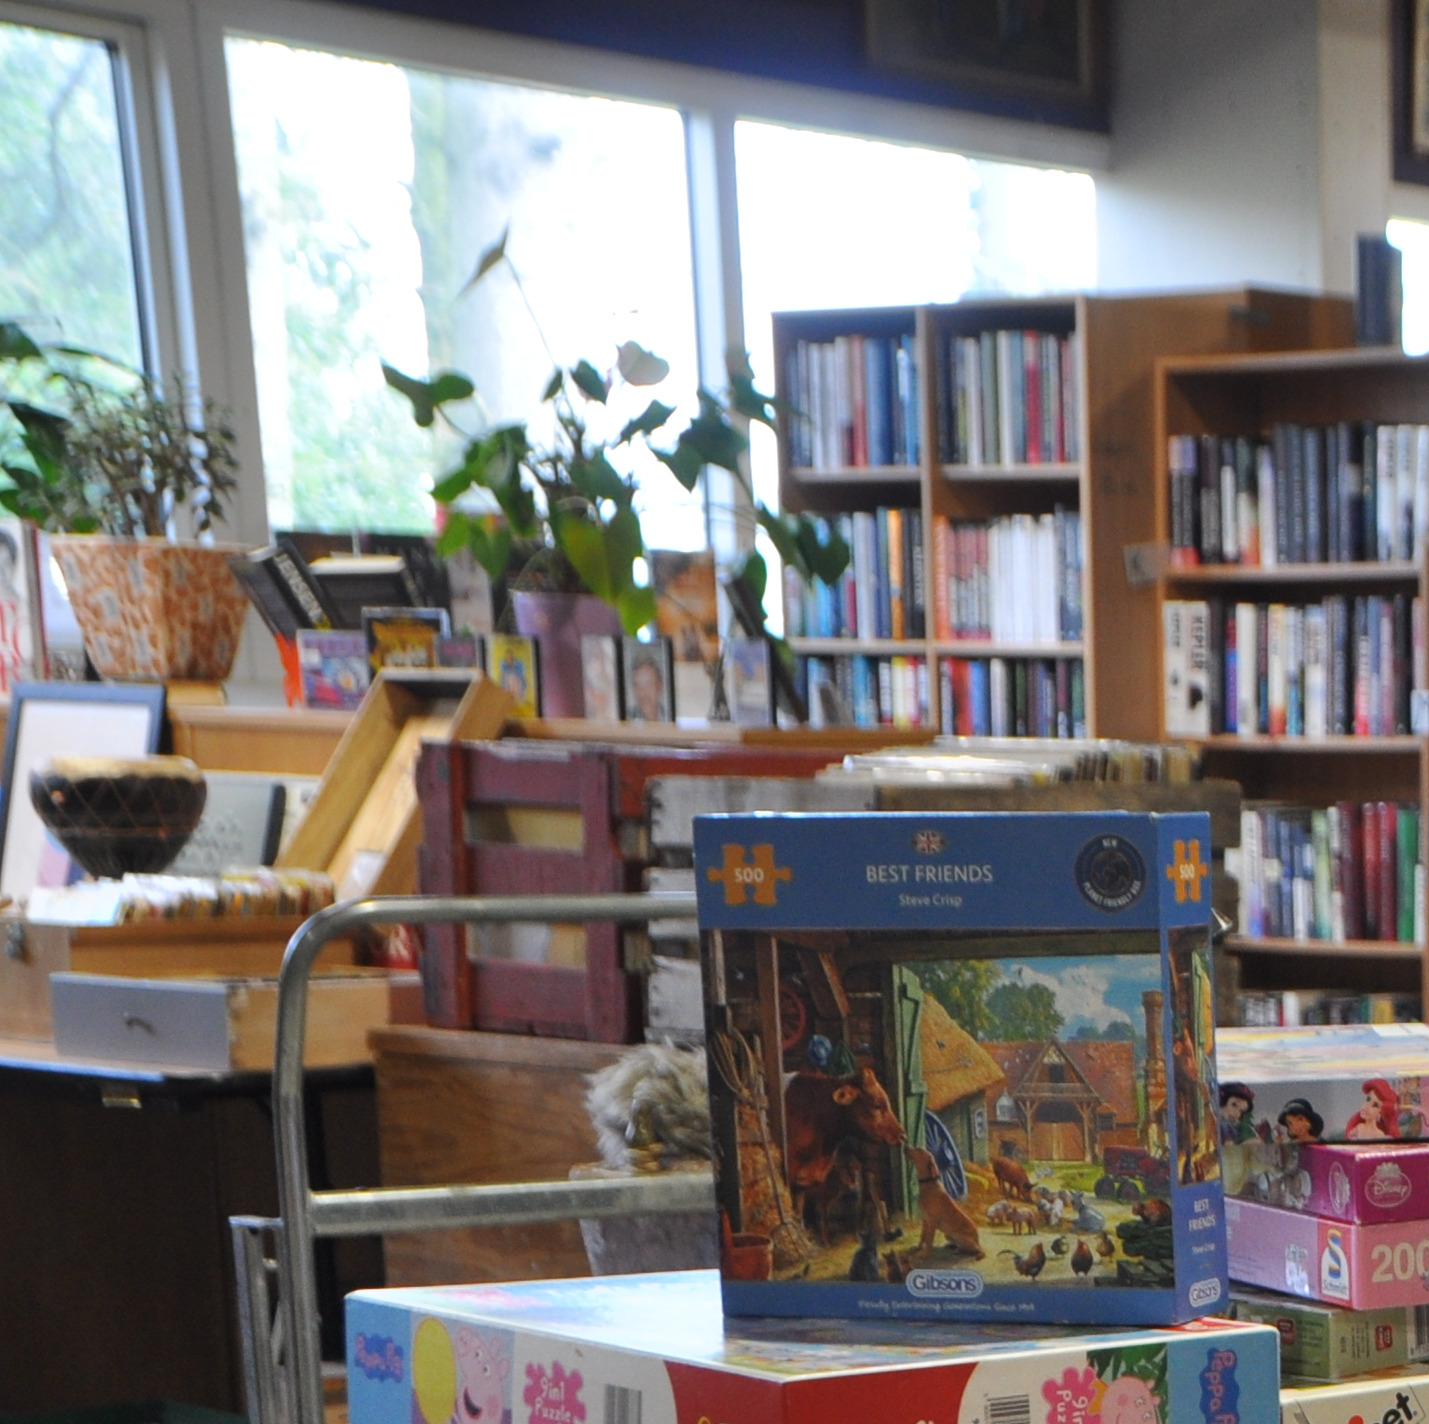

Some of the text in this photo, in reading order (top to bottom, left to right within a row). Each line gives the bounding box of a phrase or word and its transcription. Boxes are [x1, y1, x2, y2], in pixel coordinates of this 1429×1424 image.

[734, 867, 766, 884] 500
[865, 863, 994, 884] BEST FRIENDS
[898, 893, 964, 909] Steve Crisp
[911, 1273, 978, 1293] Gibsons
[1208, 1350, 1235, 1412] Peppa
[533, 1397, 573, 1424] Puzzle
